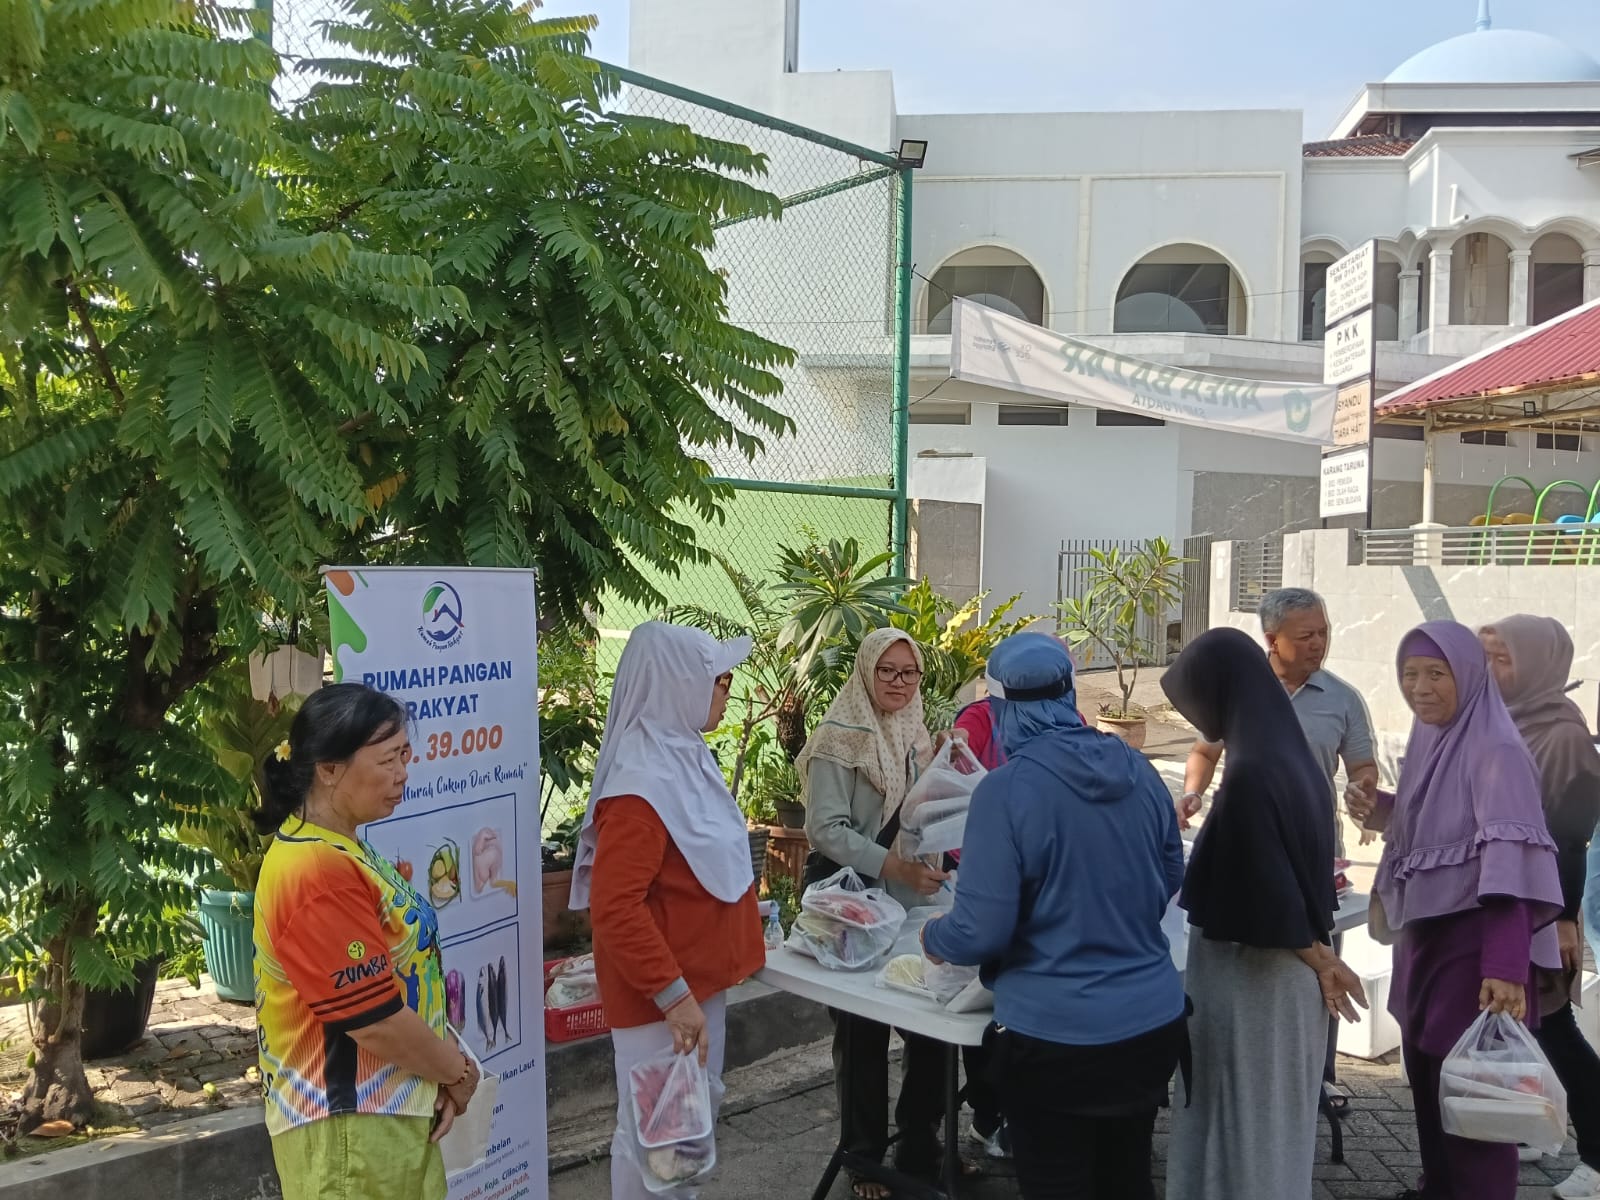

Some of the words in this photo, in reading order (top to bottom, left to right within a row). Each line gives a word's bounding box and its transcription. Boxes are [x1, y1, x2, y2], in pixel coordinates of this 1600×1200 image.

[1329, 247, 1369, 278] SEKRETARIAT
[1336, 322, 1359, 346] PKK
[1337, 394, 1362, 412] SYANDU
[363, 667, 436, 692] RUMAH
[438, 661, 512, 686] PANGAN
[405, 693, 479, 721] RAKYAT
[426, 724, 503, 761] 39.000
[437, 776, 467, 794] Cukup
[469, 769, 491, 788] Dari
[329, 954, 389, 990] ZUMBA
[503, 1068, 518, 1081] Ikan
[520, 1058, 535, 1073] Laut
[492, 1103, 504, 1116] ran
[485, 1136, 511, 1158] mbelan
